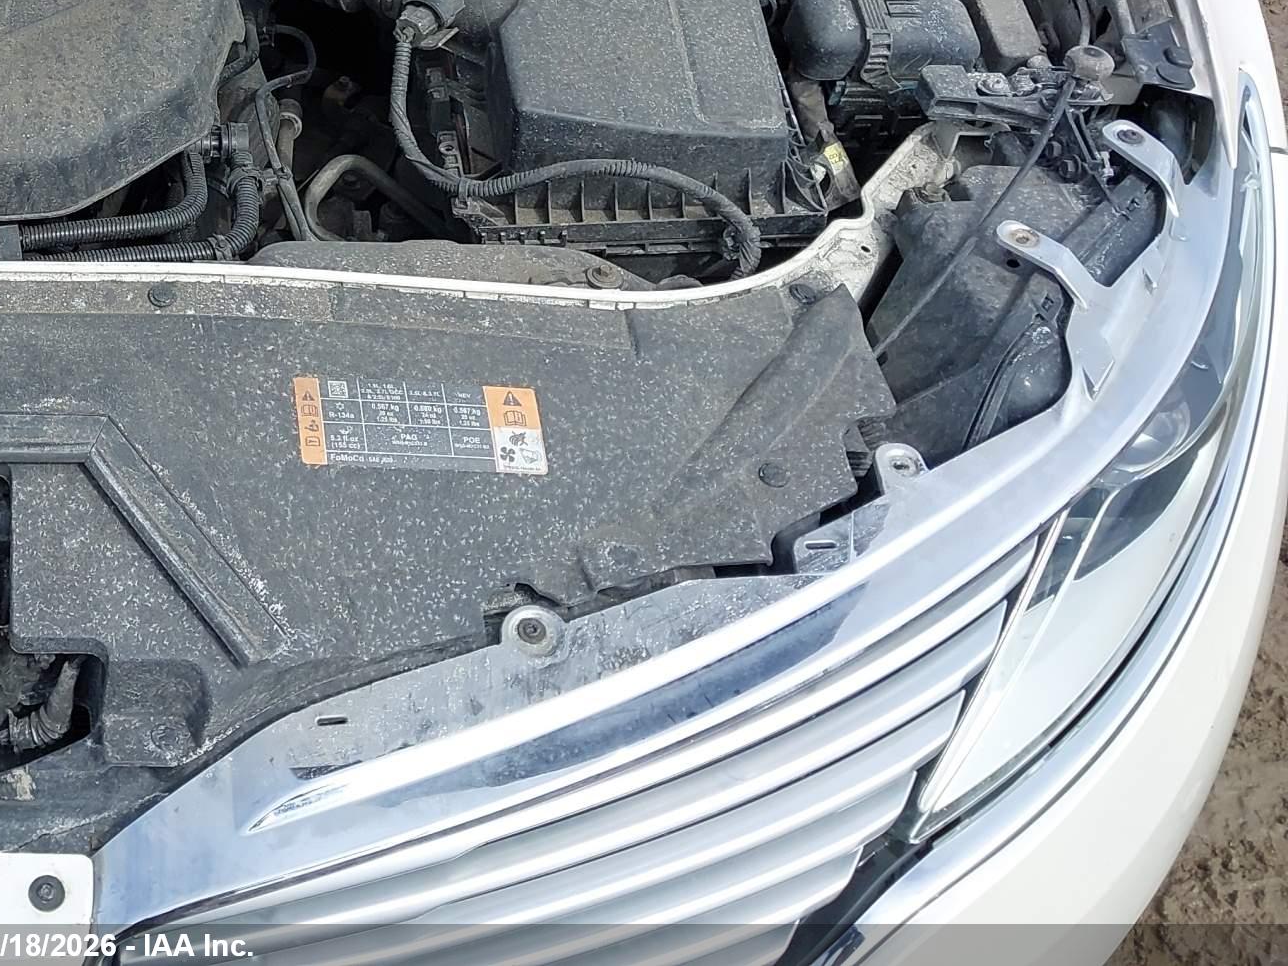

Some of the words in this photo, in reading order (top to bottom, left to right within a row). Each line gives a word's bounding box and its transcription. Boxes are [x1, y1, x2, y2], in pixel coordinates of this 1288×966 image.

[329, 411, 355, 420] R-134a
[400, 433, 418, 441] PAG
[463, 436, 481, 444] POE
[330, 453, 364, 462] FoMoCo
